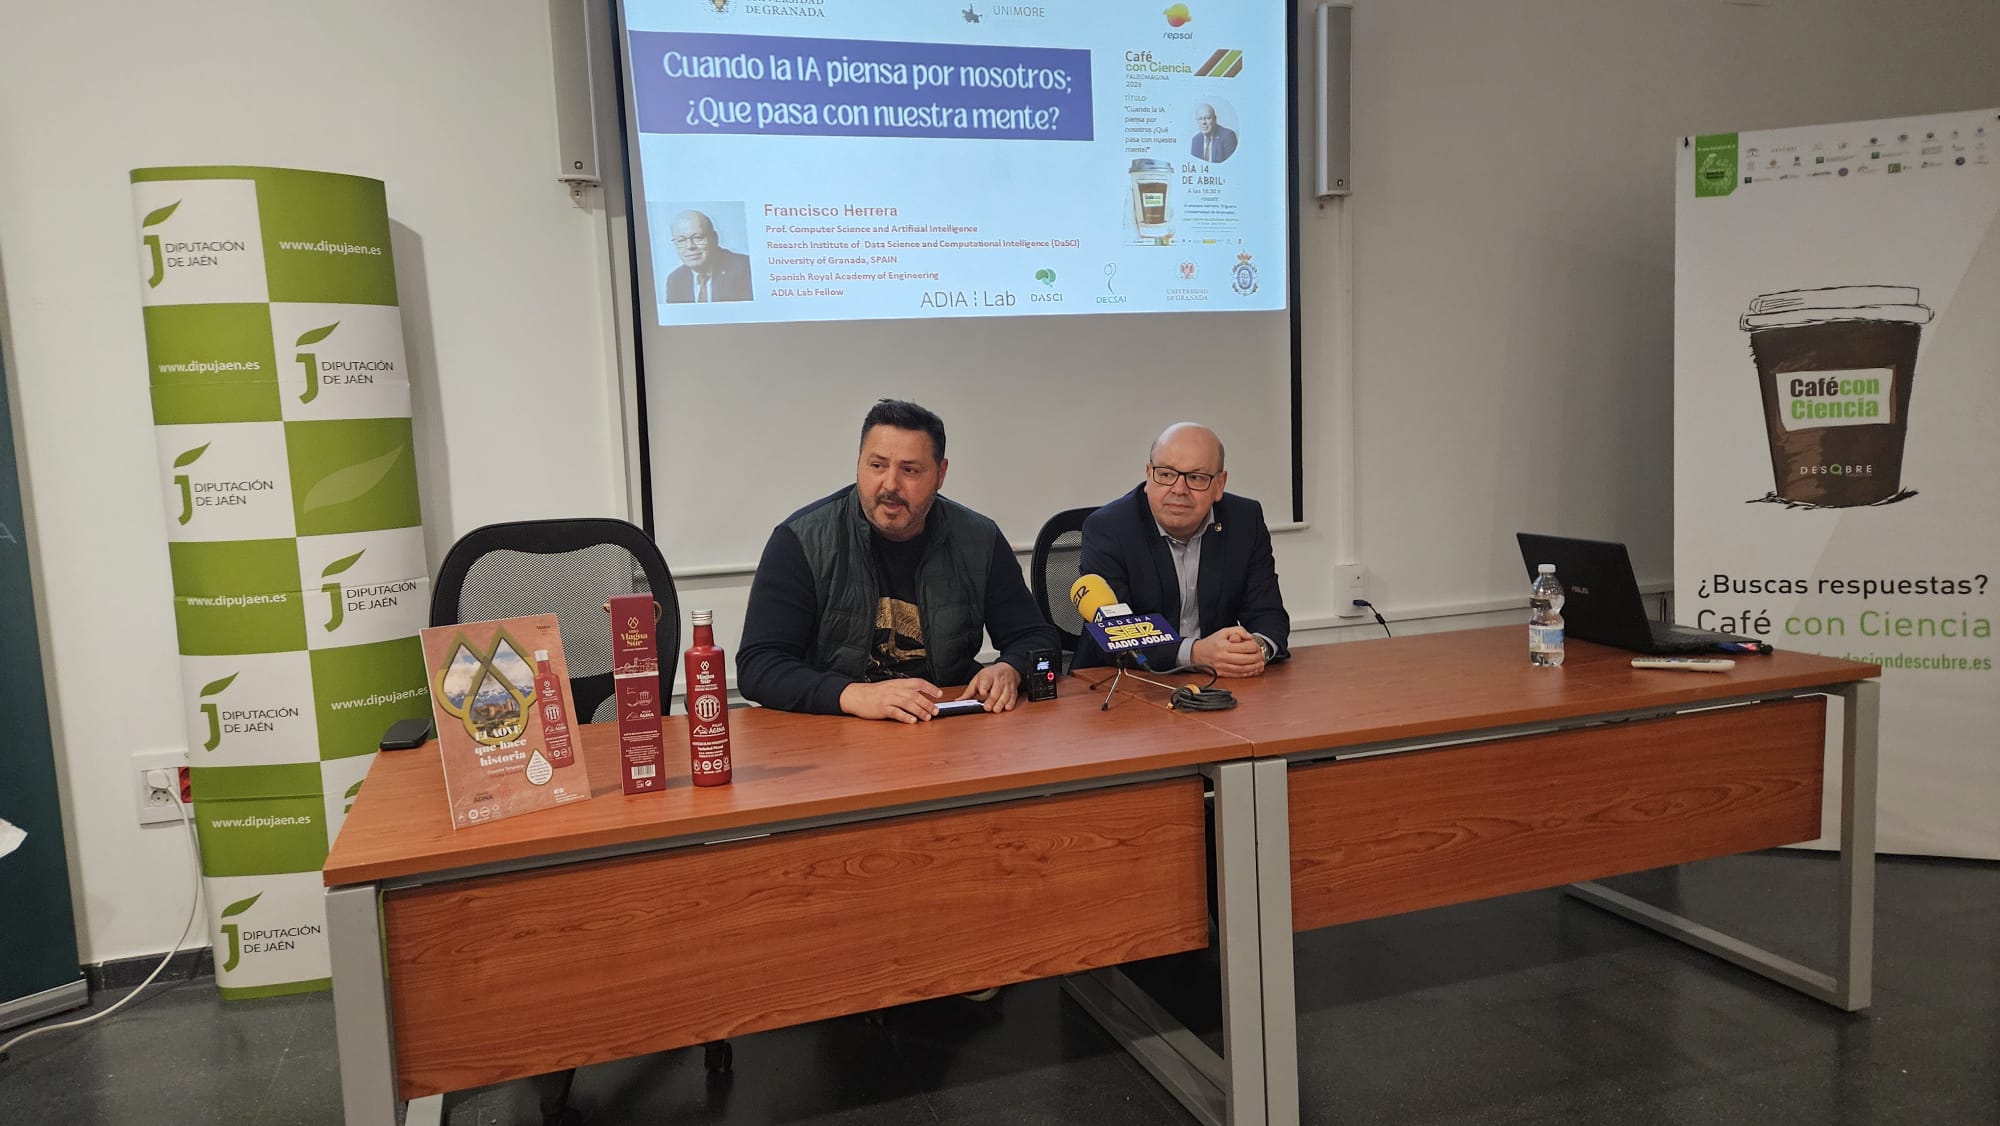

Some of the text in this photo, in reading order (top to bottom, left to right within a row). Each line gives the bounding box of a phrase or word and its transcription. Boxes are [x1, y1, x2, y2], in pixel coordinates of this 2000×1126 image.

[746, 5, 825, 17] DE GRANADA
[993, 5, 1045, 18] UNIMORE
[1163, 32, 1193, 41] repsol
[1125, 51, 1152, 62] Café
[663, 51, 1072, 94] Cuando la IA piensa por nosotros;
[1126, 62, 1192, 73] con Ciencia
[686, 97, 1060, 130] ¿Que pasa con nuestra mente?
[1182, 162, 1209, 174] DÍA 14
[1182, 176, 1194, 185] DE
[764, 204, 898, 217] Francisco Herrera
[765, 224, 978, 235] Prof. Computer Science and Artificial Intelligence
[165, 240, 245, 254] DIPUTACIÓN
[279, 240, 382, 256] www.dipujaen.es
[767, 239, 1080, 249] Research Institute of Data Science and Computational Intelligence (DaSCI)
[167, 254, 218, 267] DE JAÉN
[768, 256, 898, 266] University of Granada, SPAIN
[770, 271, 940, 282] Spanish Royal Academy of Engineering
[771, 288, 844, 297] ADIA Lab Fellow
[921, 290, 1016, 309] ADIA Lab
[158, 360, 260, 374] www.dipujaen.es
[321, 360, 394, 372] DIPUTACIÓN
[323, 372, 374, 385] DE JAÉN
[1791, 397, 1879, 419] Ciencia
[194, 479, 273, 494] DIPUTACIÓN
[195, 493, 247, 507] DE JAÉN
[346, 581, 417, 599] DIPUTACIÓN
[1697, 574, 1988, 599] ¿Buscas respuestas?
[187, 592, 287, 608] www.dipujaen.es
[348, 597, 398, 612] DE JAÉN
[1098, 616, 1151, 628] CADENA
[1697, 609, 1991, 638] Café con Ciencia
[1105, 622, 1162, 642] SER
[1107, 633, 1174, 650] RADIO JODAR
[331, 686, 428, 710] www.dipujaen.es
[222, 707, 299, 721] DIPUTACIÓN
[224, 720, 274, 733] DE JAÉN
[475, 739, 527, 756] que hace
[480, 750, 527, 767] historia
[212, 813, 311, 829] www.dipujaen.es
[243, 925, 321, 941] DIPUTACIÓN
[244, 940, 295, 954] DE JAÉN
